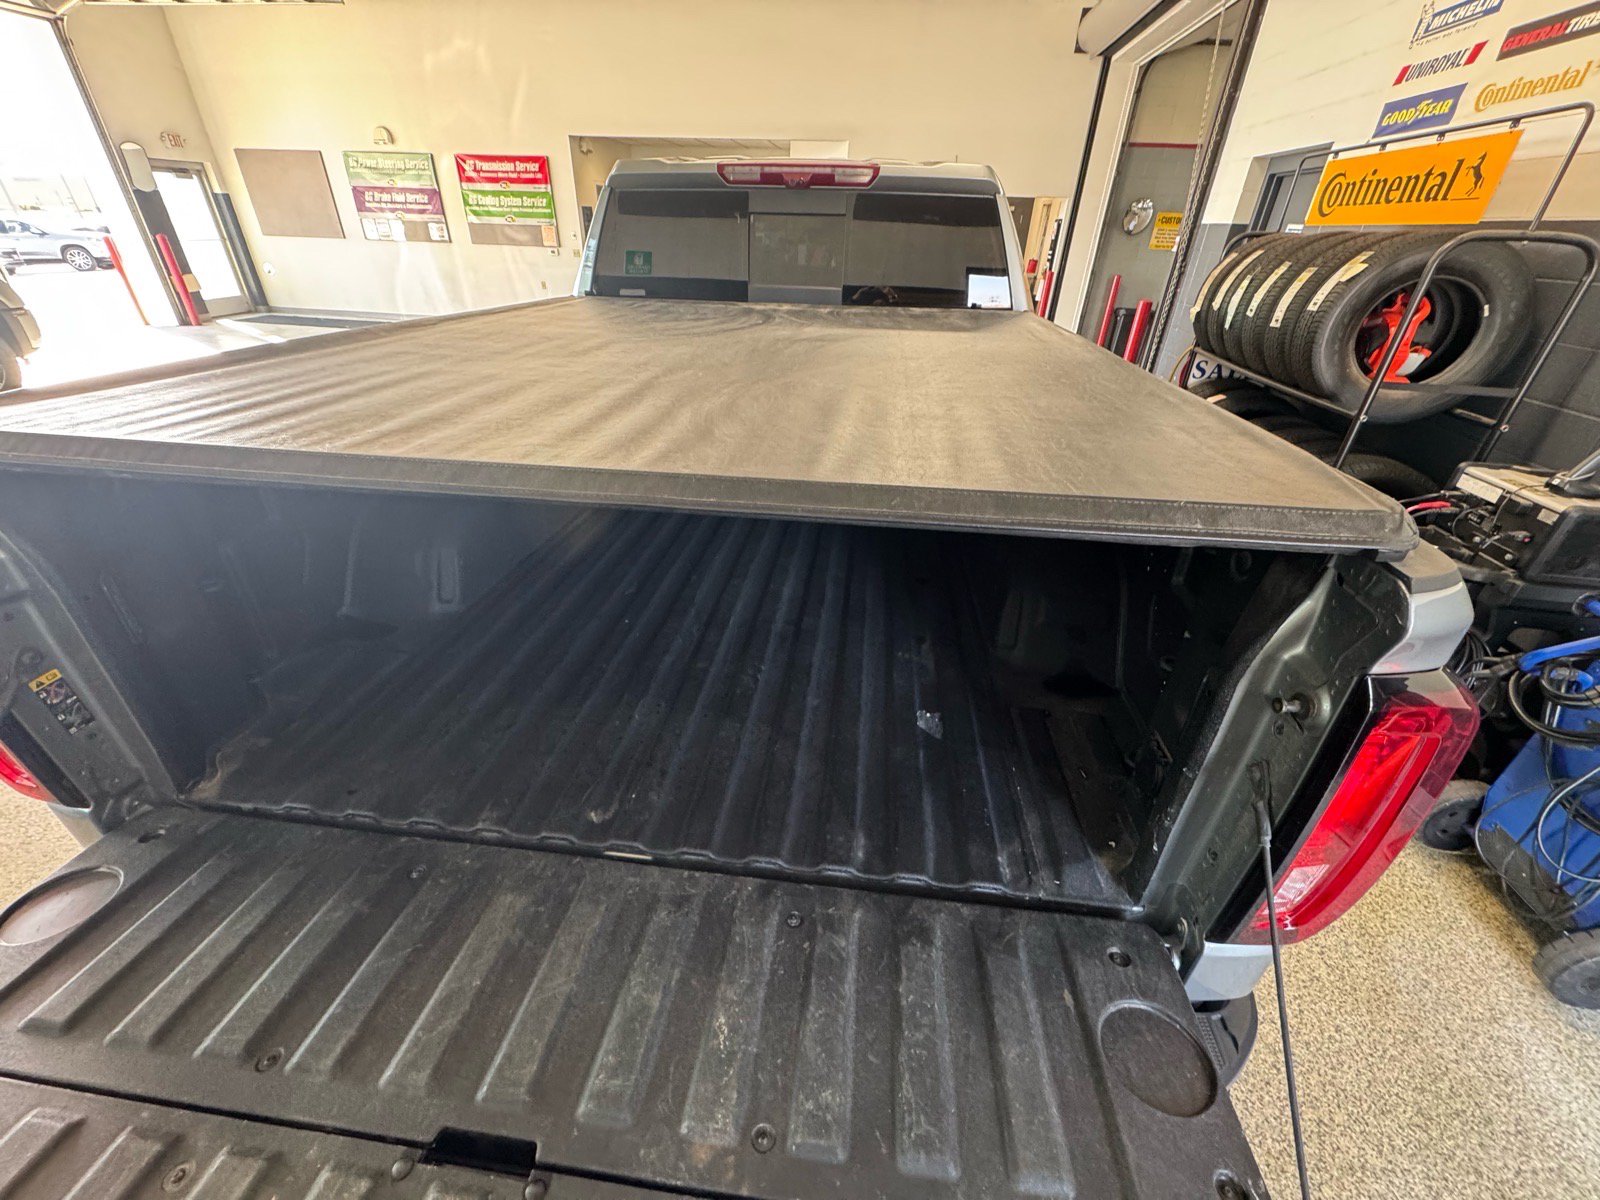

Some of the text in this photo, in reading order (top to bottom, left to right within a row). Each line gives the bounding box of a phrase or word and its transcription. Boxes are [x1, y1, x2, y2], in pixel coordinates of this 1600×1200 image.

[1428, 0, 1501, 31] MICHELIN
[1501, 20, 1569, 52] GENERAL
[1405, 48, 1468, 82] UNIROYAL
[1474, 60, 1594, 113] Continental
[1381, 99, 1454, 126] GOODYEAR
[405, 159, 429, 169] Service
[475, 160, 515, 171] Transmission
[515, 161, 540, 172] Service
[406, 192, 429, 203] Service
[522, 195, 547, 207] Service
[1318, 159, 1464, 217] Continental
[1160, 216, 1183, 225] CUSTO
